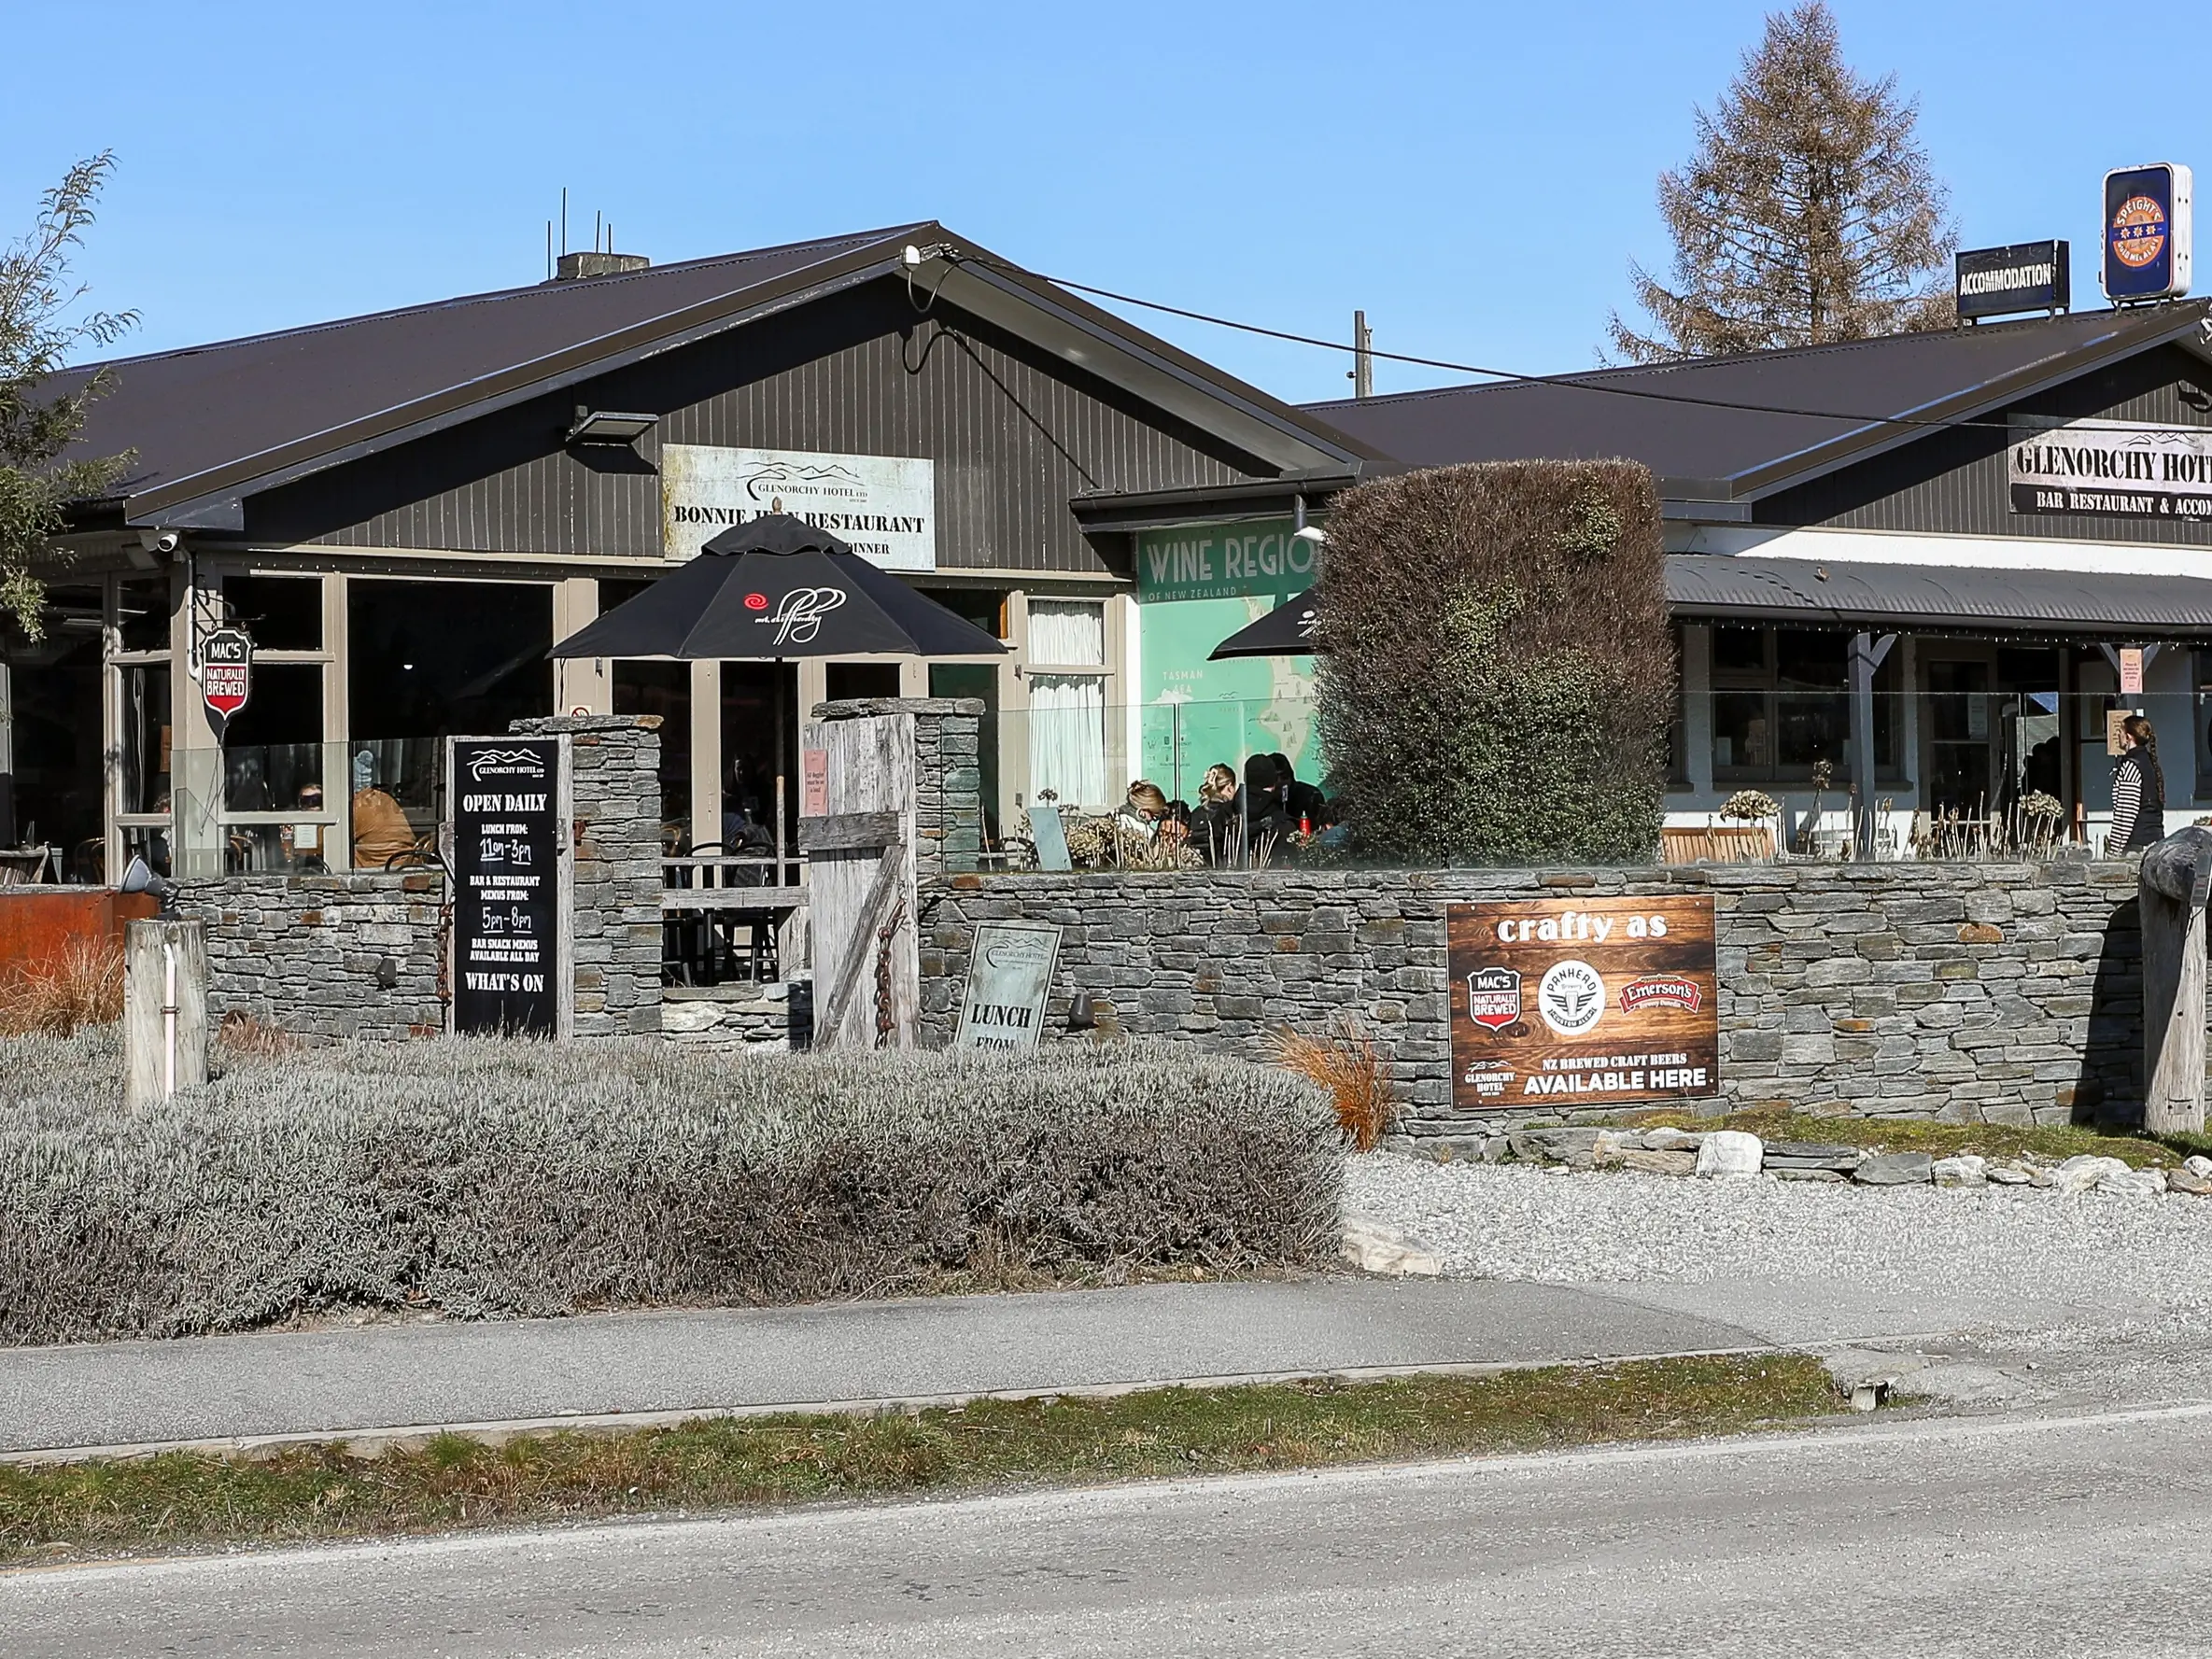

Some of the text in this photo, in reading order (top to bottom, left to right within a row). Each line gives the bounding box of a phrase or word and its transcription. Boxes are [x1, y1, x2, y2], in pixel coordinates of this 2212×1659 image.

[2117, 199, 2161, 226] SPEIGHT'S
[1960, 263, 2051, 296] ACCOMMODATION
[2017, 445, 2157, 481] GLENORCHY
[758, 484, 820, 495] GLENORCHY
[824, 487, 854, 497] HOTEL
[2036, 491, 2064, 509] BAR
[2070, 493, 2154, 513] RESTAURANT
[2160, 498, 2169, 513] &
[674, 505, 747, 526] BONNIE
[805, 513, 925, 534] RESTAURANT
[1147, 534, 1315, 584] WINE REGIO
[1148, 586, 1237, 602] OF NEW ZEALAND
[211, 641, 241, 659] MAC'S
[206, 668, 246, 681] NATURALLY
[1162, 669, 1204, 681] TASMAN
[206, 681, 245, 696] BREWED
[463, 794, 547, 812] OPEN DAILY
[481, 823, 528, 835] LUNCH FROM:
[470, 876, 541, 887] BAR & RESTAURANT
[481, 890, 529, 901] MENUS FROM:
[1497, 911, 1669, 944] crafty as
[472, 938, 538, 949] BAR SNACK MENUS
[470, 950, 540, 963] AVAILABLE ALL DAY
[466, 972, 544, 992] WHAT'S ON
[1477, 976, 1512, 990] MAC'S
[1546, 968, 1597, 991] PANHEAD
[1473, 994, 1516, 1005] NATURALLY
[1627, 983, 1693, 1001] Emerson's
[971, 1004, 1032, 1028] LUNCH
[1473, 1004, 1517, 1016] BREWED
[1543, 1053, 1687, 1071] NZ BREWED CRAFT BEERS
[1465, 1072, 1515, 1083] GLENORCHY
[1523, 1068, 1706, 1095] AVAILABLE HERE
[1476, 1082, 1504, 1092] HOTEL
